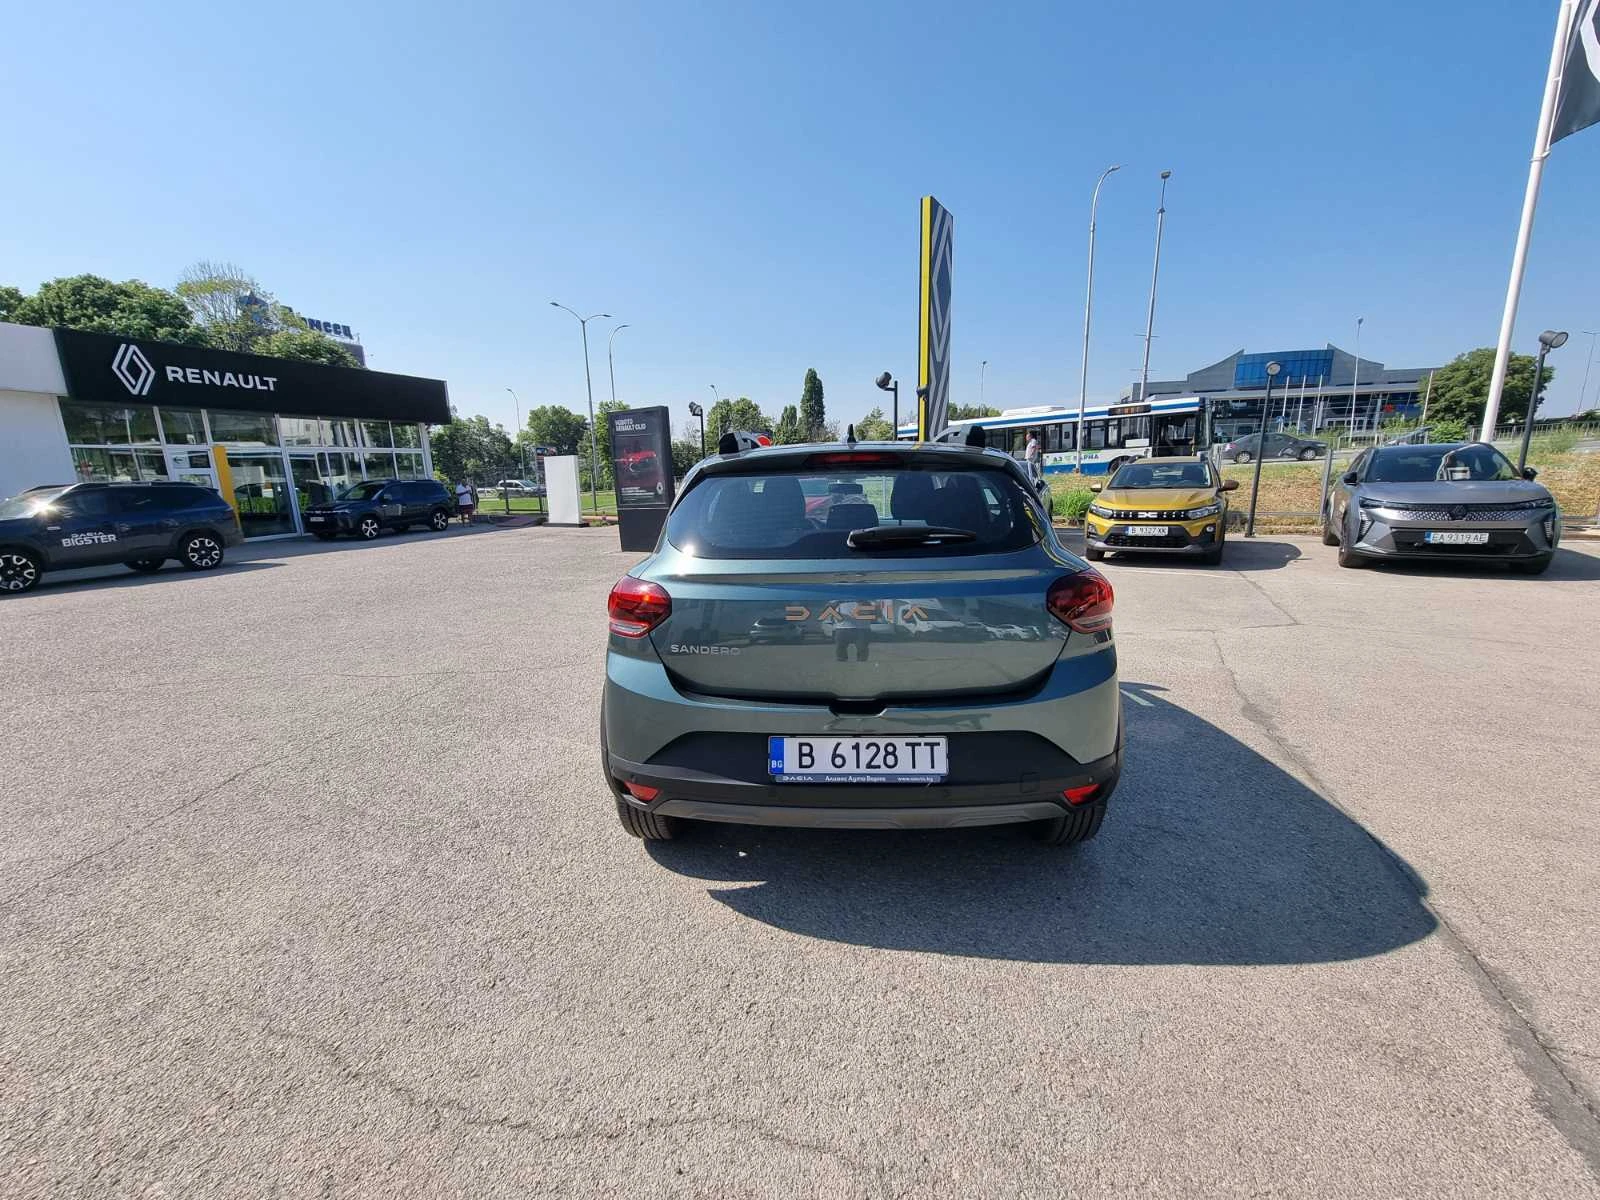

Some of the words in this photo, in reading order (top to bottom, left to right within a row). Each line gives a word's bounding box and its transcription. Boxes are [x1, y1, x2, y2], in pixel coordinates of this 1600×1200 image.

[165, 365, 278, 391] RENAULT
[62, 534, 118, 547] BIGSTER
[785, 605, 929, 624] DACIA
[670, 644, 741, 656] SANDERO
[798, 742, 815, 769] B
[831, 741, 899, 769] 6128
[905, 742, 941, 769] TT
[771, 760, 783, 768] BG
